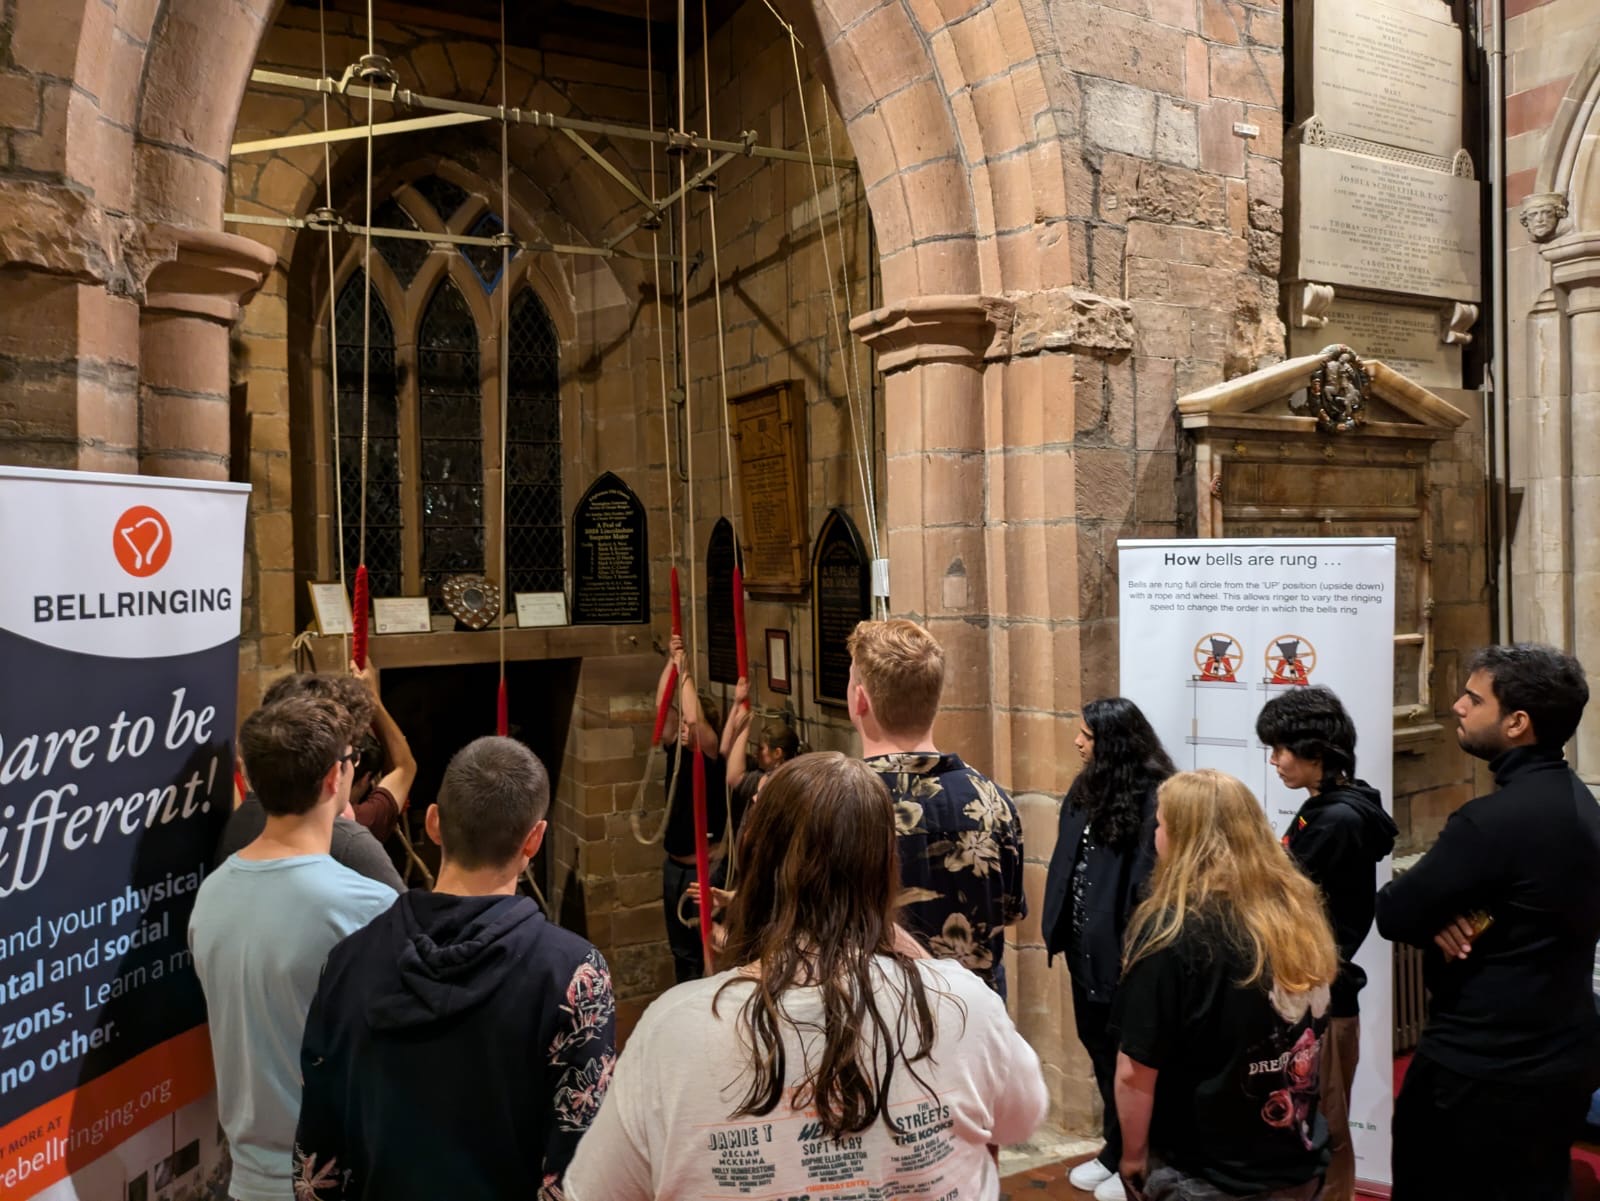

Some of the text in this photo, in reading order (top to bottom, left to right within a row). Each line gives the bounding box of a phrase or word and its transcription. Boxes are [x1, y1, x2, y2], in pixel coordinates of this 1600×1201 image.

[1164, 553, 1201, 566] How
[1206, 553, 1242, 566] bells
[1248, 555, 1274, 566] are
[1280, 555, 1317, 569] rung
[1128, 581, 1147, 589] Bells
[1164, 582, 1183, 590] rung
[1199, 581, 1222, 589] circle
[1224, 581, 1244, 589] from
[1246, 581, 1260, 589] the
[1282, 582, 1317, 591] position
[1320, 582, 1354, 591] (upside
[1355, 582, 1385, 592] down)
[1154, 593, 1174, 601] rope
[1175, 592, 1191, 600] and
[1223, 592, 1241, 600] This
[1243, 592, 1270, 601] allows
[1272, 593, 1298, 602] ringer
[1311, 595, 1331, 603] vary
[1334, 594, 1348, 602] the
[1351, 594, 1383, 604] ringing
[33, 588, 232, 623] BELLRINGING
[1150, 604, 1175, 612] speed
[1187, 604, 1218, 612] change
[1220, 604, 1234, 612] the
[1236, 604, 1259, 612] order
[1272, 605, 1298, 613] which
[1299, 605, 1314, 613] the
[1316, 606, 1338, 614] bells
[1340, 606, 1358, 615] ring
[0, 687, 215, 786] are to be
[48, 901, 107, 948] your
[111, 863, 205, 926] physical
[50, 939, 99, 983] and
[104, 912, 169, 962] social
[85, 966, 147, 1012] Learn
[152, 959, 164, 980] a
[1, 1020, 120, 1094] no other.
[896, 1105, 950, 1132] STREETS
[917, 1103, 929, 1112] THE
[9, 1126, 43, 1154] MORE
[47, 1116, 62, 1133] AT
[708, 1124, 772, 1151] JAMIE T
[918, 1119, 954, 1140] KOOKS
[722, 1149, 760, 1158] DECLAN
[802, 1136, 862, 1156] SOFT PLAY
[719, 1157, 766, 1166] MCKENNA
